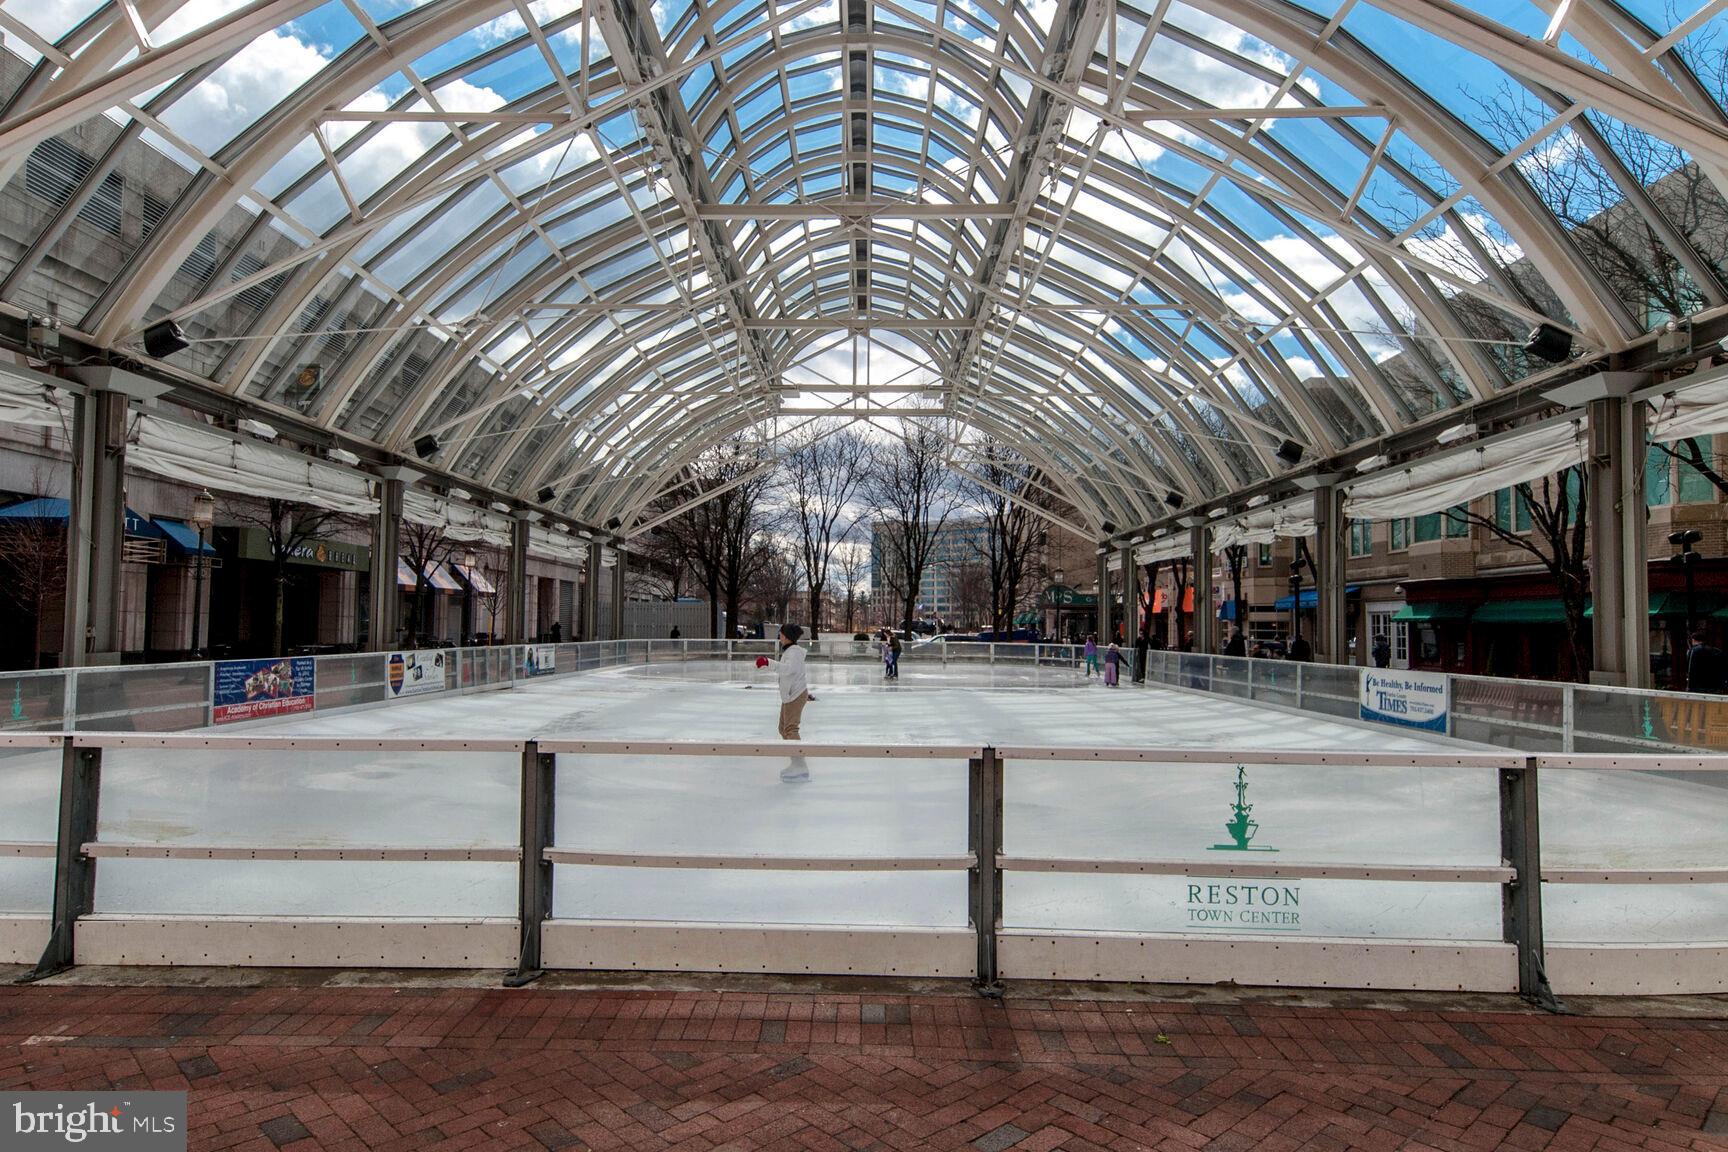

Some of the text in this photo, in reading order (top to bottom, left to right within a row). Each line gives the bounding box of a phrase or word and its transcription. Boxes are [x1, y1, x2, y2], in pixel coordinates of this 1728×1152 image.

[1372, 678, 1443, 694] Be Healthy, Be Informed
[227, 703, 252, 715] Academy
[252, 703, 259, 711] of
[259, 700, 281, 710] Christian
[282, 697, 306, 707] Education
[1376, 690, 1408, 714] TIMES
[1187, 884, 1300, 906] RESTON
[1187, 908, 1300, 924] TOWN CENTER
